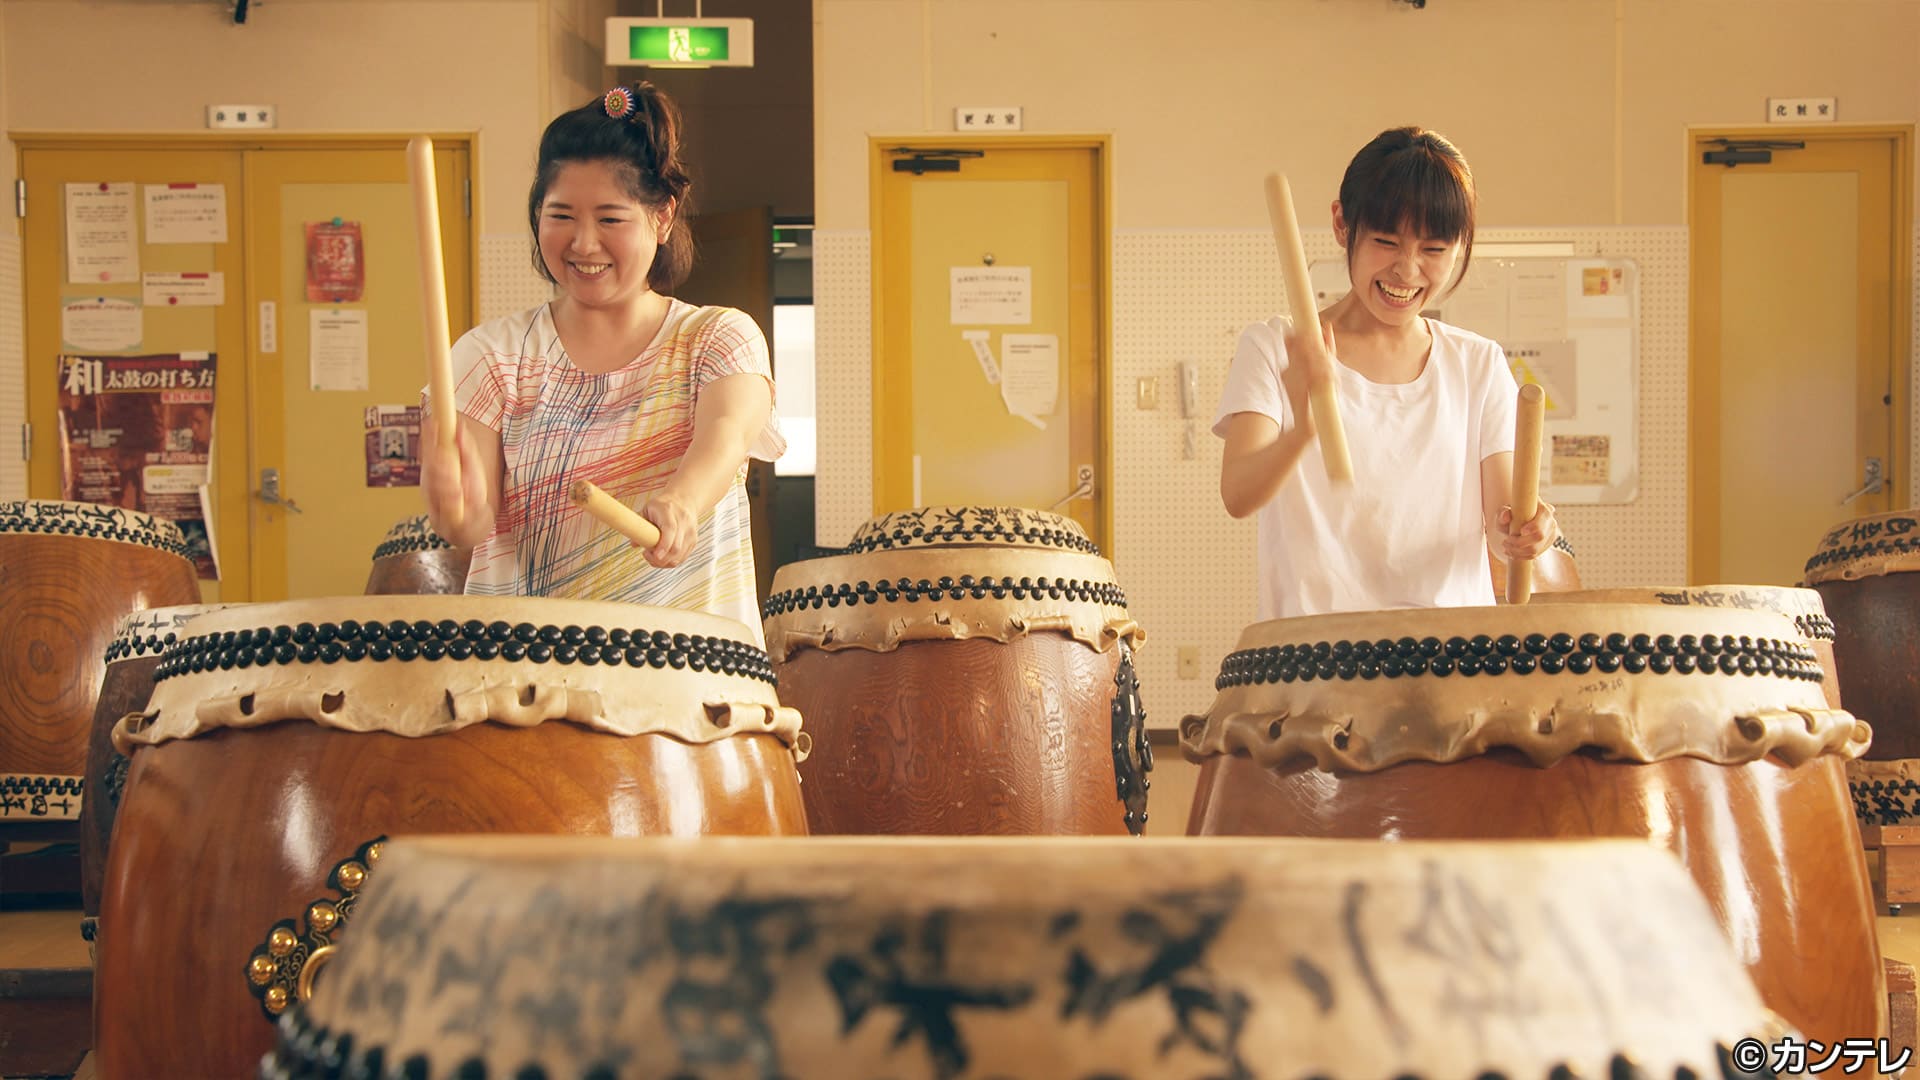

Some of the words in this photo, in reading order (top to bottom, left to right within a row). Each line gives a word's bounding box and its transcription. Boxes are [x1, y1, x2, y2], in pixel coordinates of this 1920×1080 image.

[105, 369, 215, 389] 太鼓の打ち方
